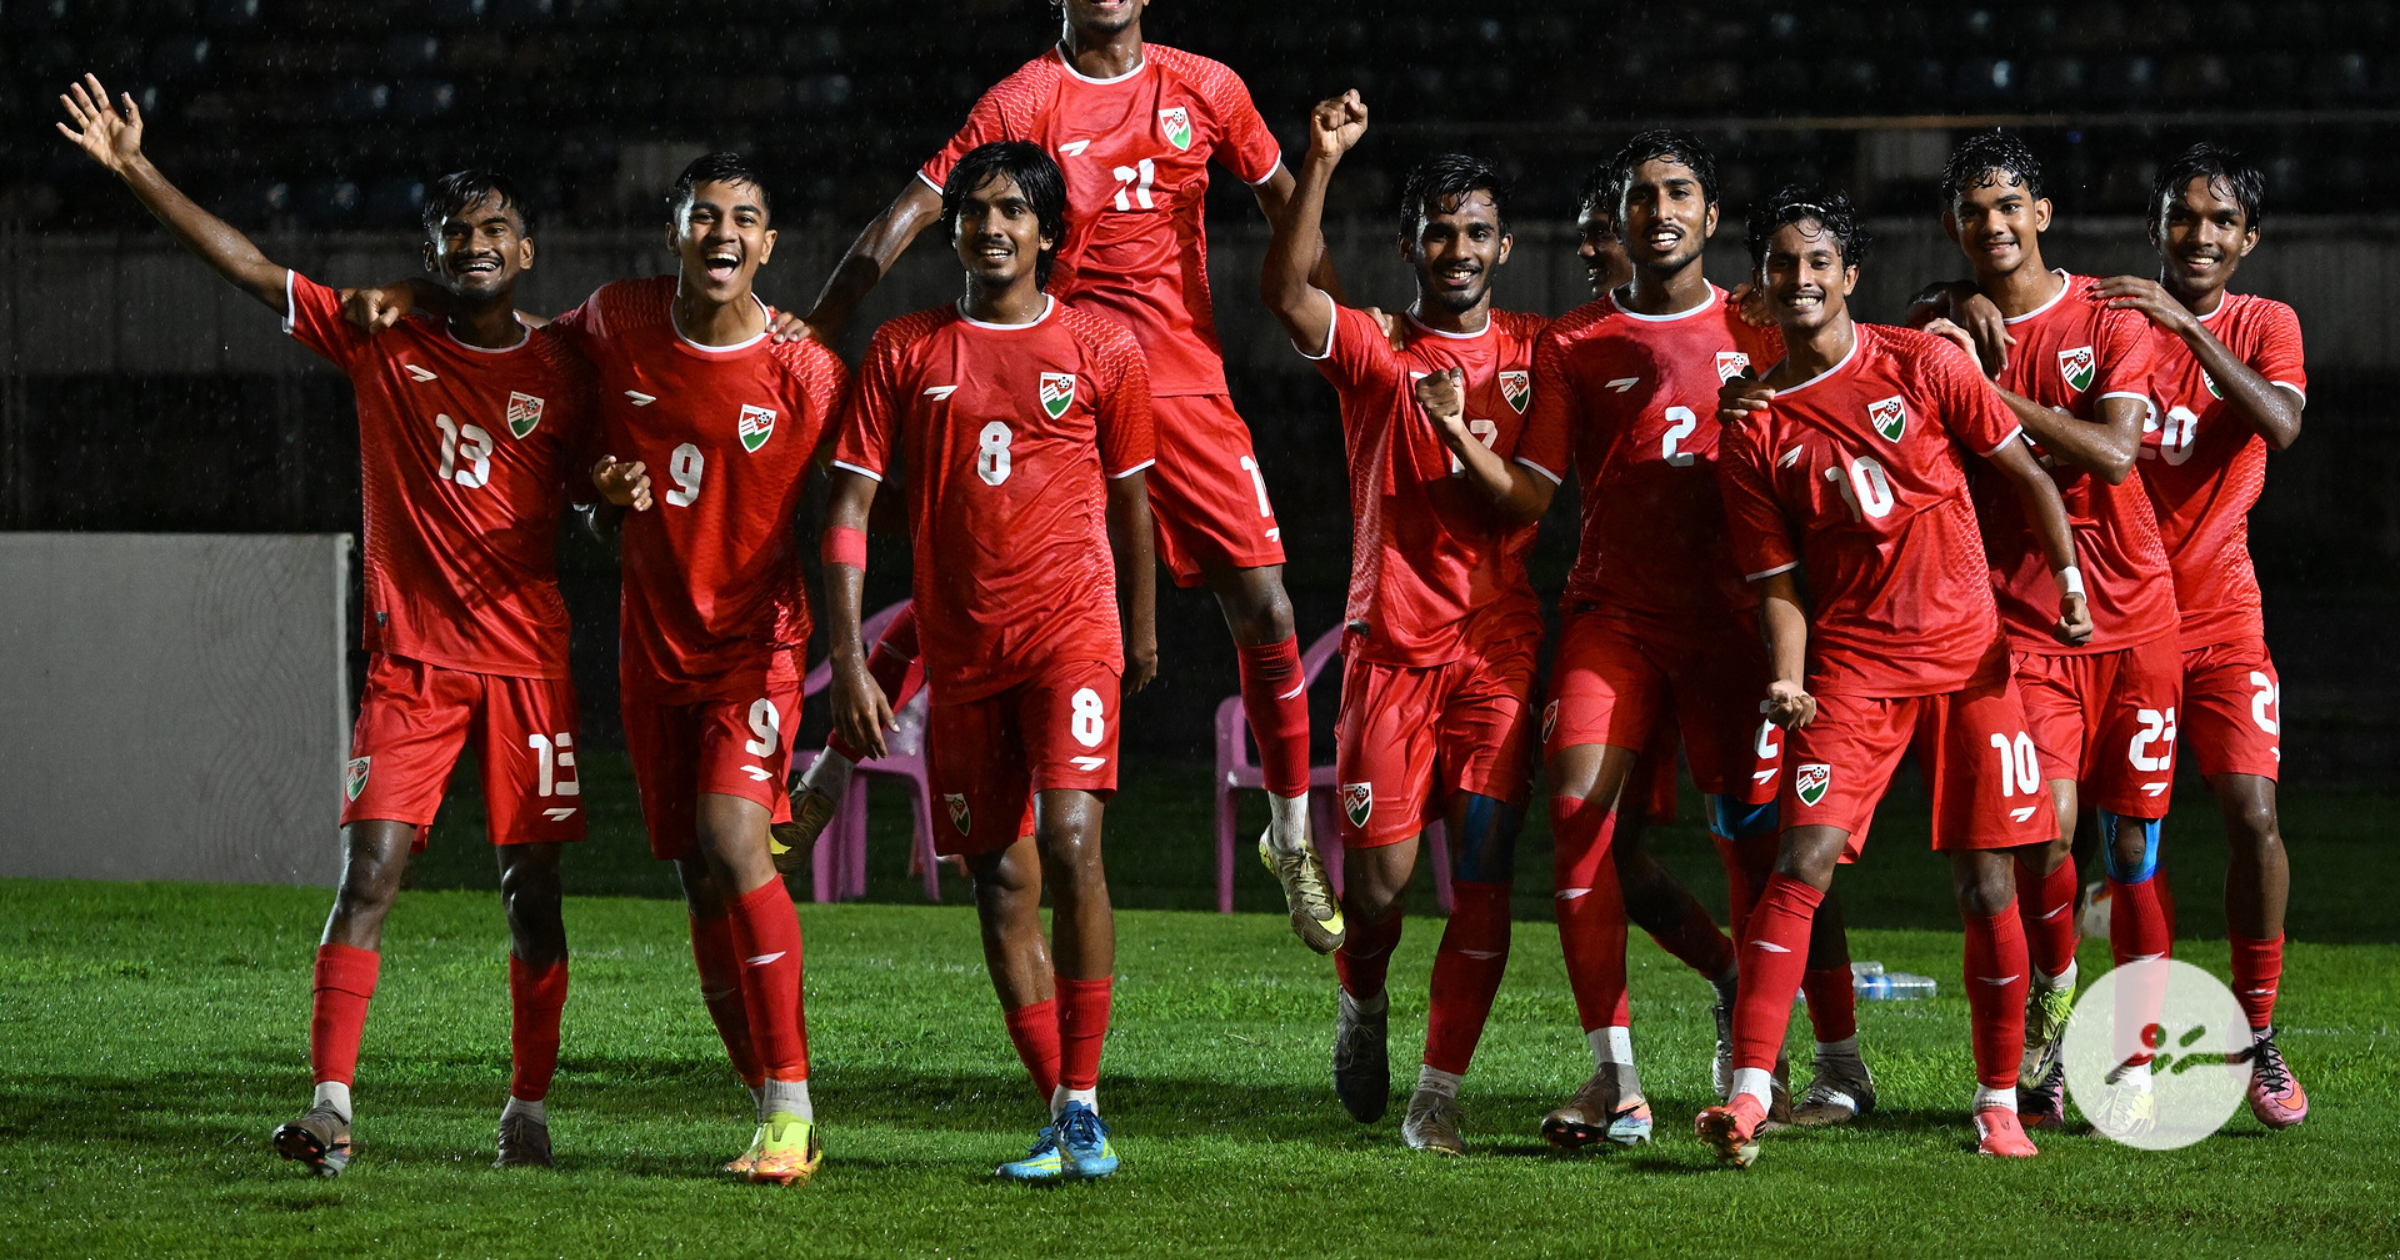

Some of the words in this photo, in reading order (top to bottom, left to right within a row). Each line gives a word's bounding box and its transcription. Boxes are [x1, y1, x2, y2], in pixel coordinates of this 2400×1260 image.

[1112, 158, 1155, 212] 11
[435, 412, 493, 489] 13
[978, 421, 1013, 486] 8
[1662, 405, 1697, 467] 2
[665, 443, 704, 507] 9
[1239, 455, 1275, 517] 1
[1824, 455, 1894, 523] 10
[745, 698, 780, 757] 9
[1071, 688, 1104, 748] 8
[2249, 671, 2280, 736] 2
[529, 732, 580, 796] 13
[1990, 731, 2039, 797] 10
[2128, 706, 2177, 771] 23
